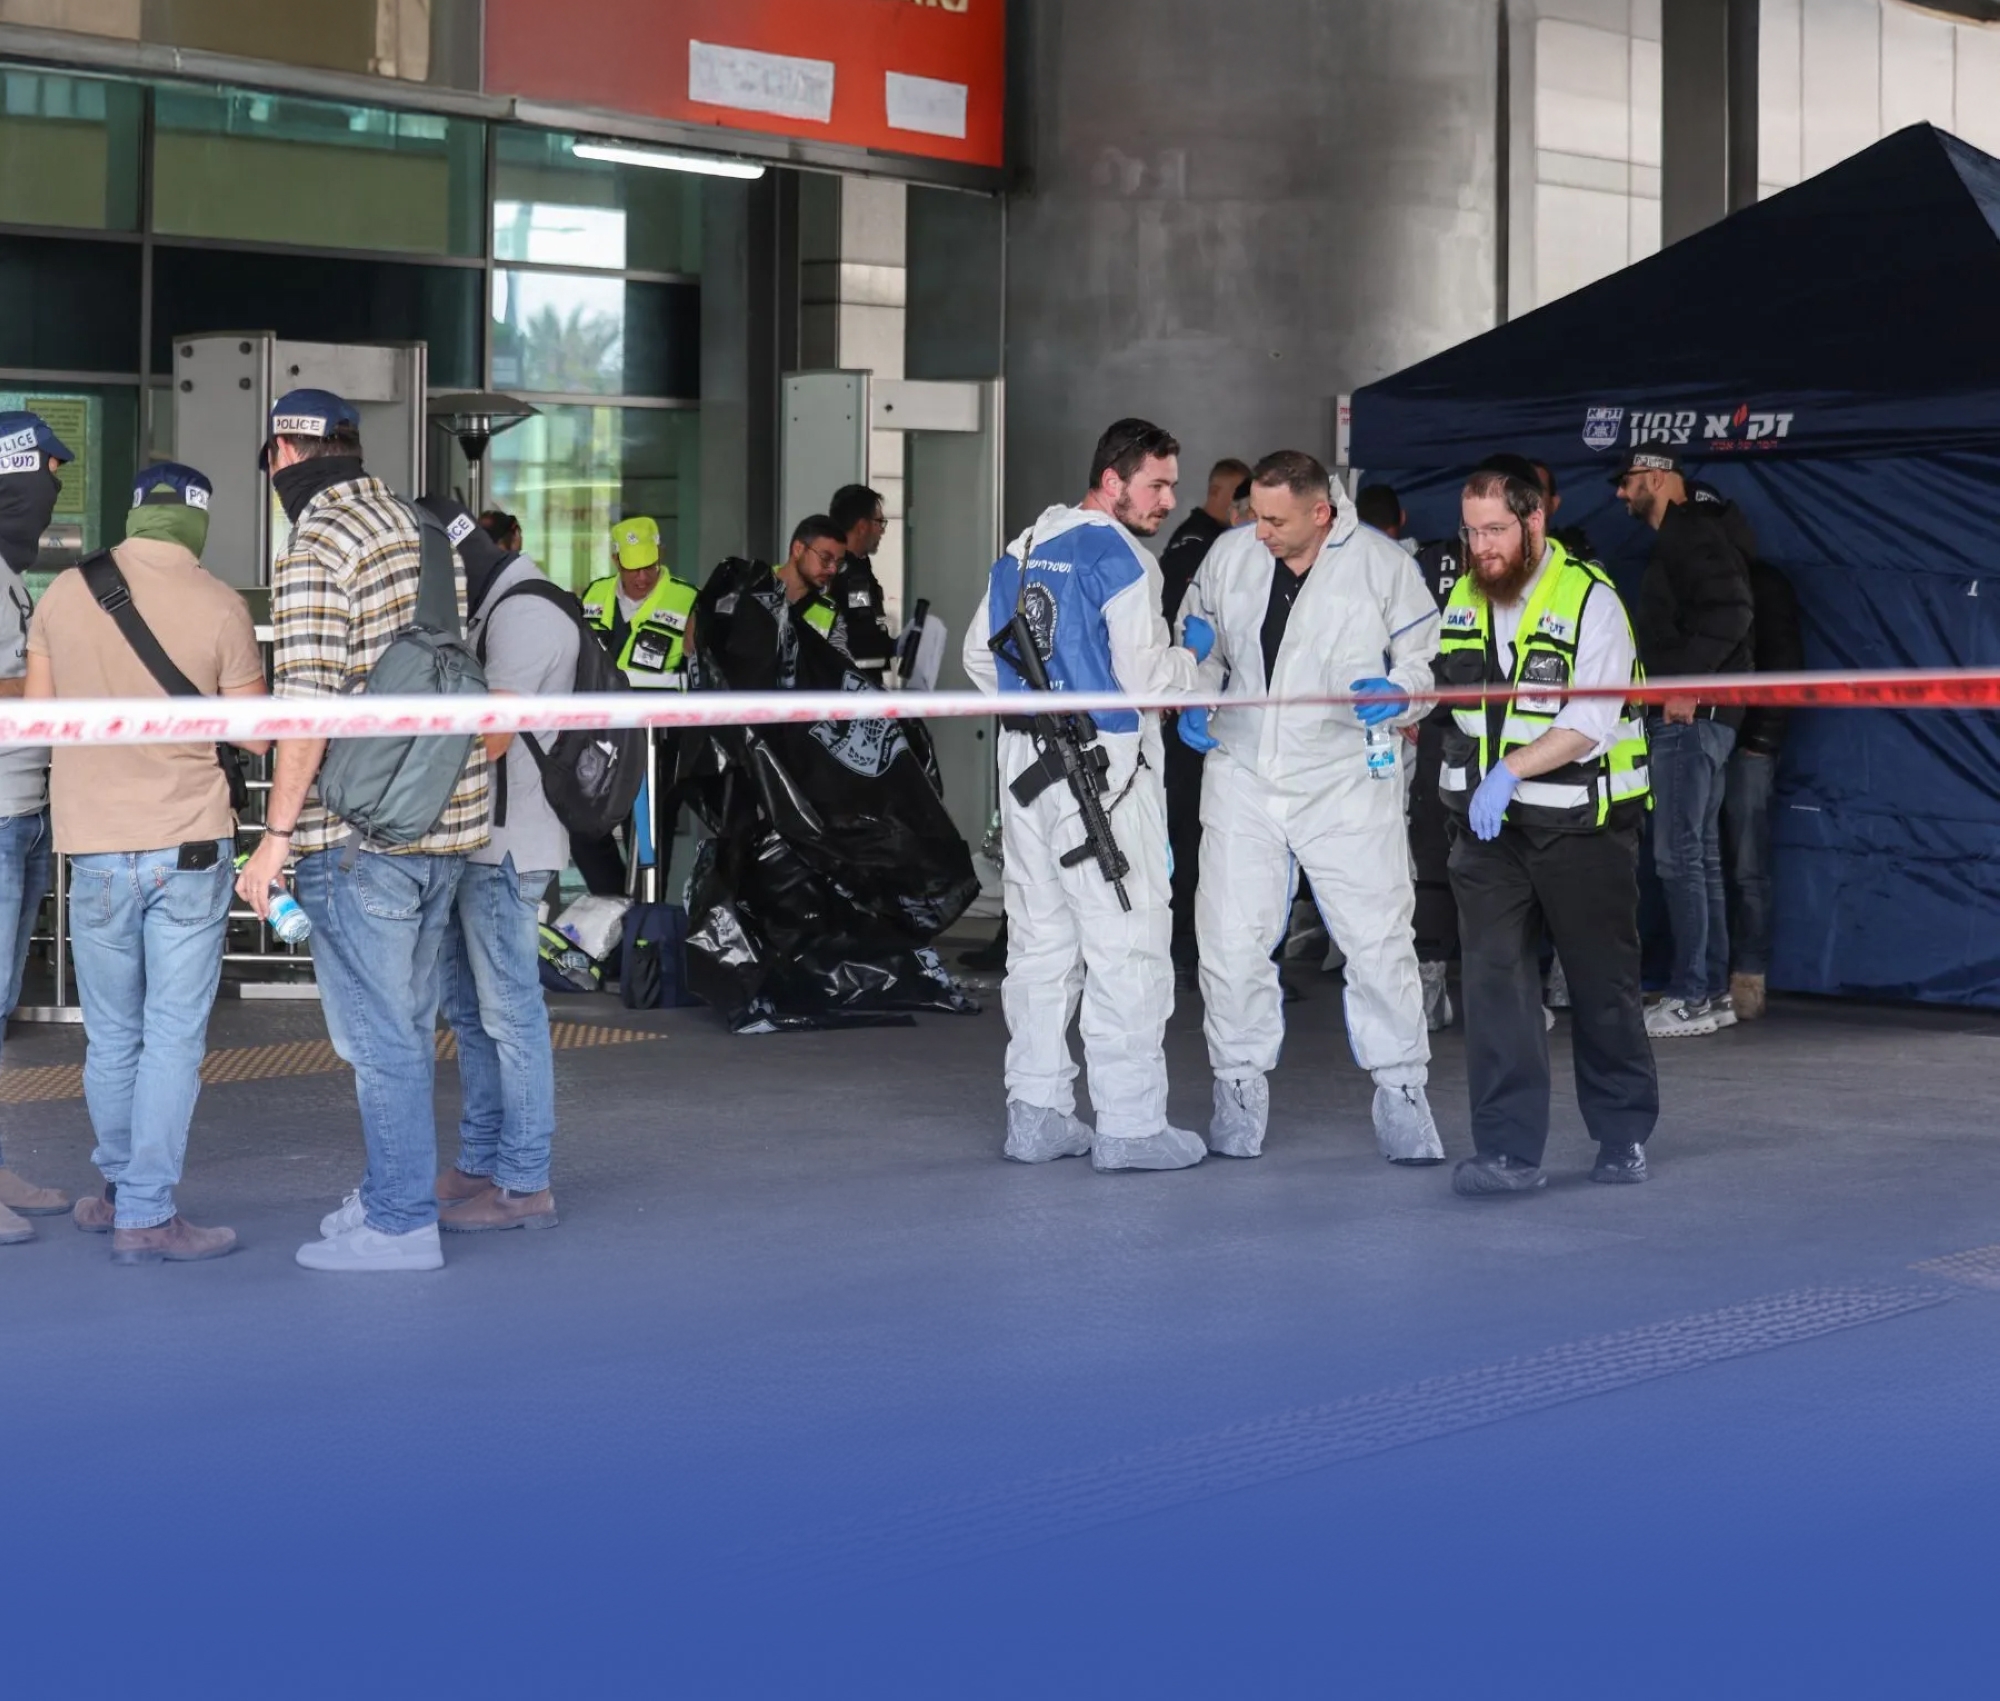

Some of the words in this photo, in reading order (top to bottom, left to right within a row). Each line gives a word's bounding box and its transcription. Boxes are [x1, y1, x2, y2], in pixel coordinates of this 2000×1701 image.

[276, 418, 320, 431] POLICE
[1629, 411, 1696, 428] מחוז
[0, 432, 34, 453] LICE
[1629, 428, 1690, 447] צפון
[0, 455, 35, 468] משט
[448, 518, 470, 540] ICE
